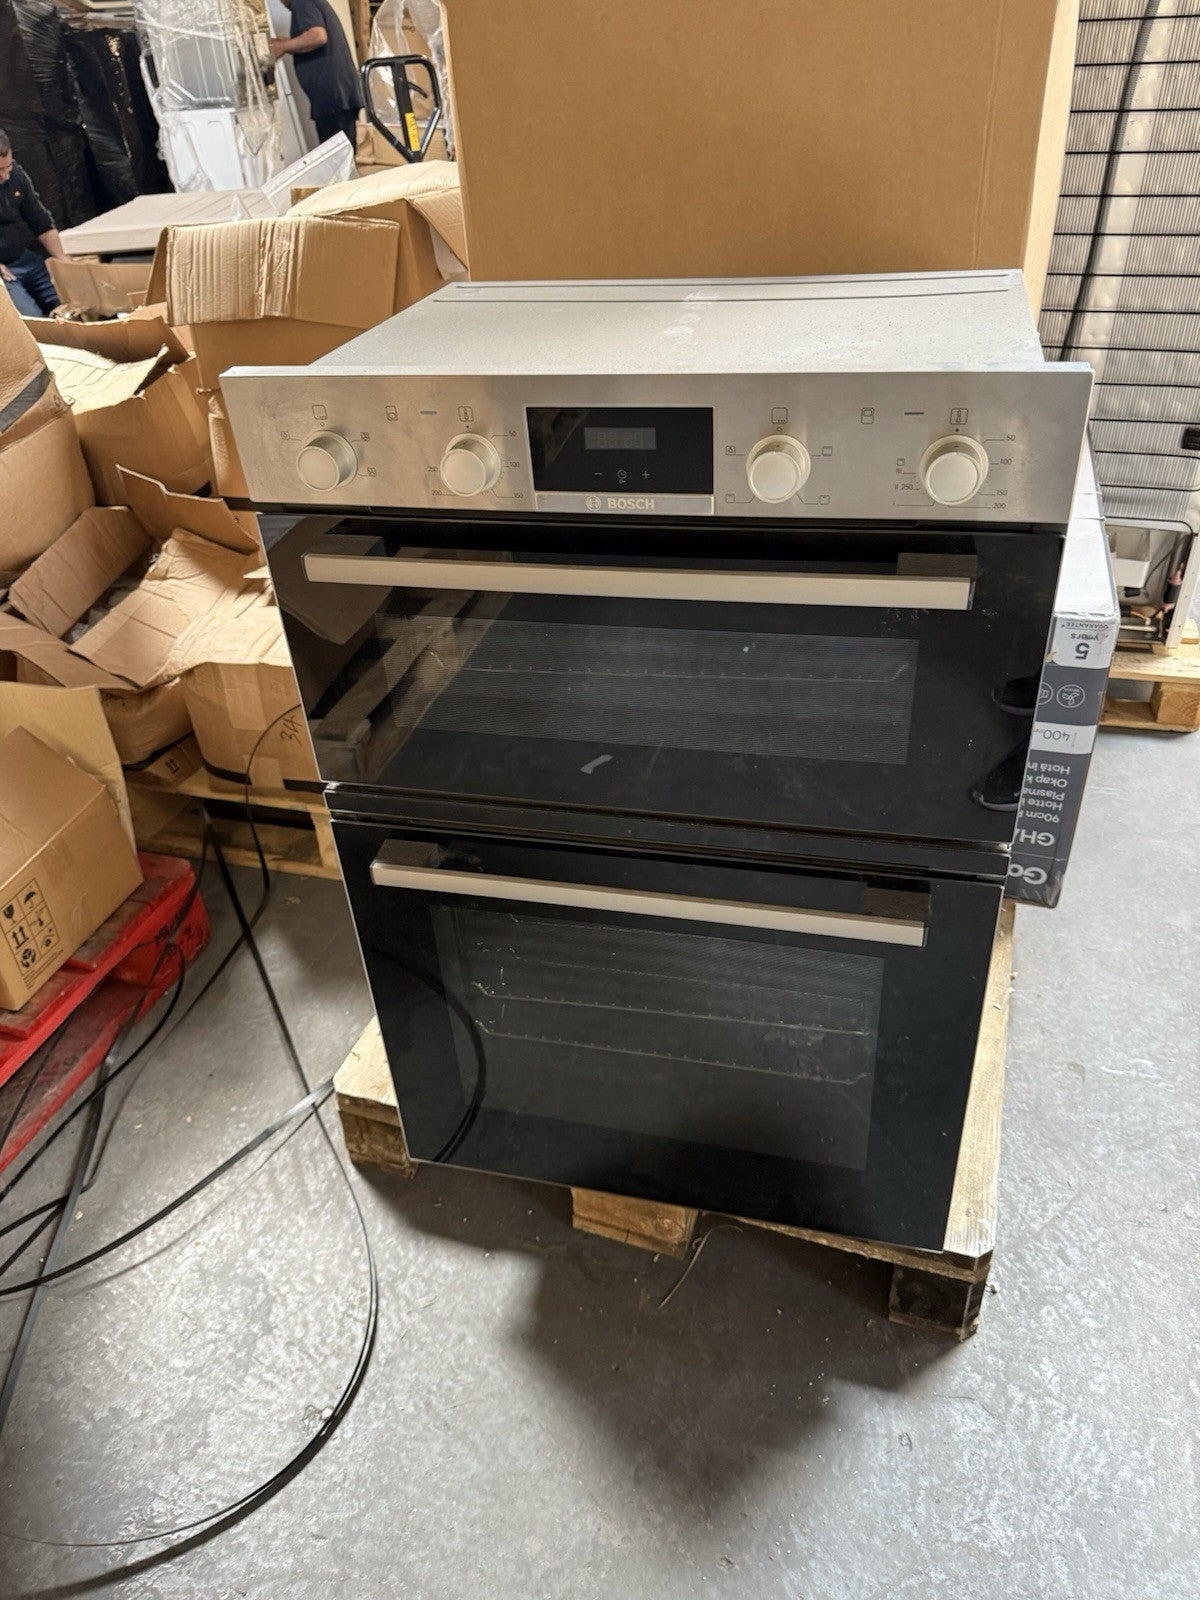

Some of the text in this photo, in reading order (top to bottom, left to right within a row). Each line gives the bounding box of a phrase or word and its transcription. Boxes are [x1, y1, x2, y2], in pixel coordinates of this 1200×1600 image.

[996, 489, 1008, 497] 150
[607, 497, 655, 510] BOSCH
[1070, 632, 1099, 641] years
[1075, 642, 1090, 660] 5
[1035, 774, 1068, 788] Okap
[1027, 797, 1063, 811] Hotte
[1025, 810, 1060, 823] 90cm
[1009, 863, 1048, 885] Go
